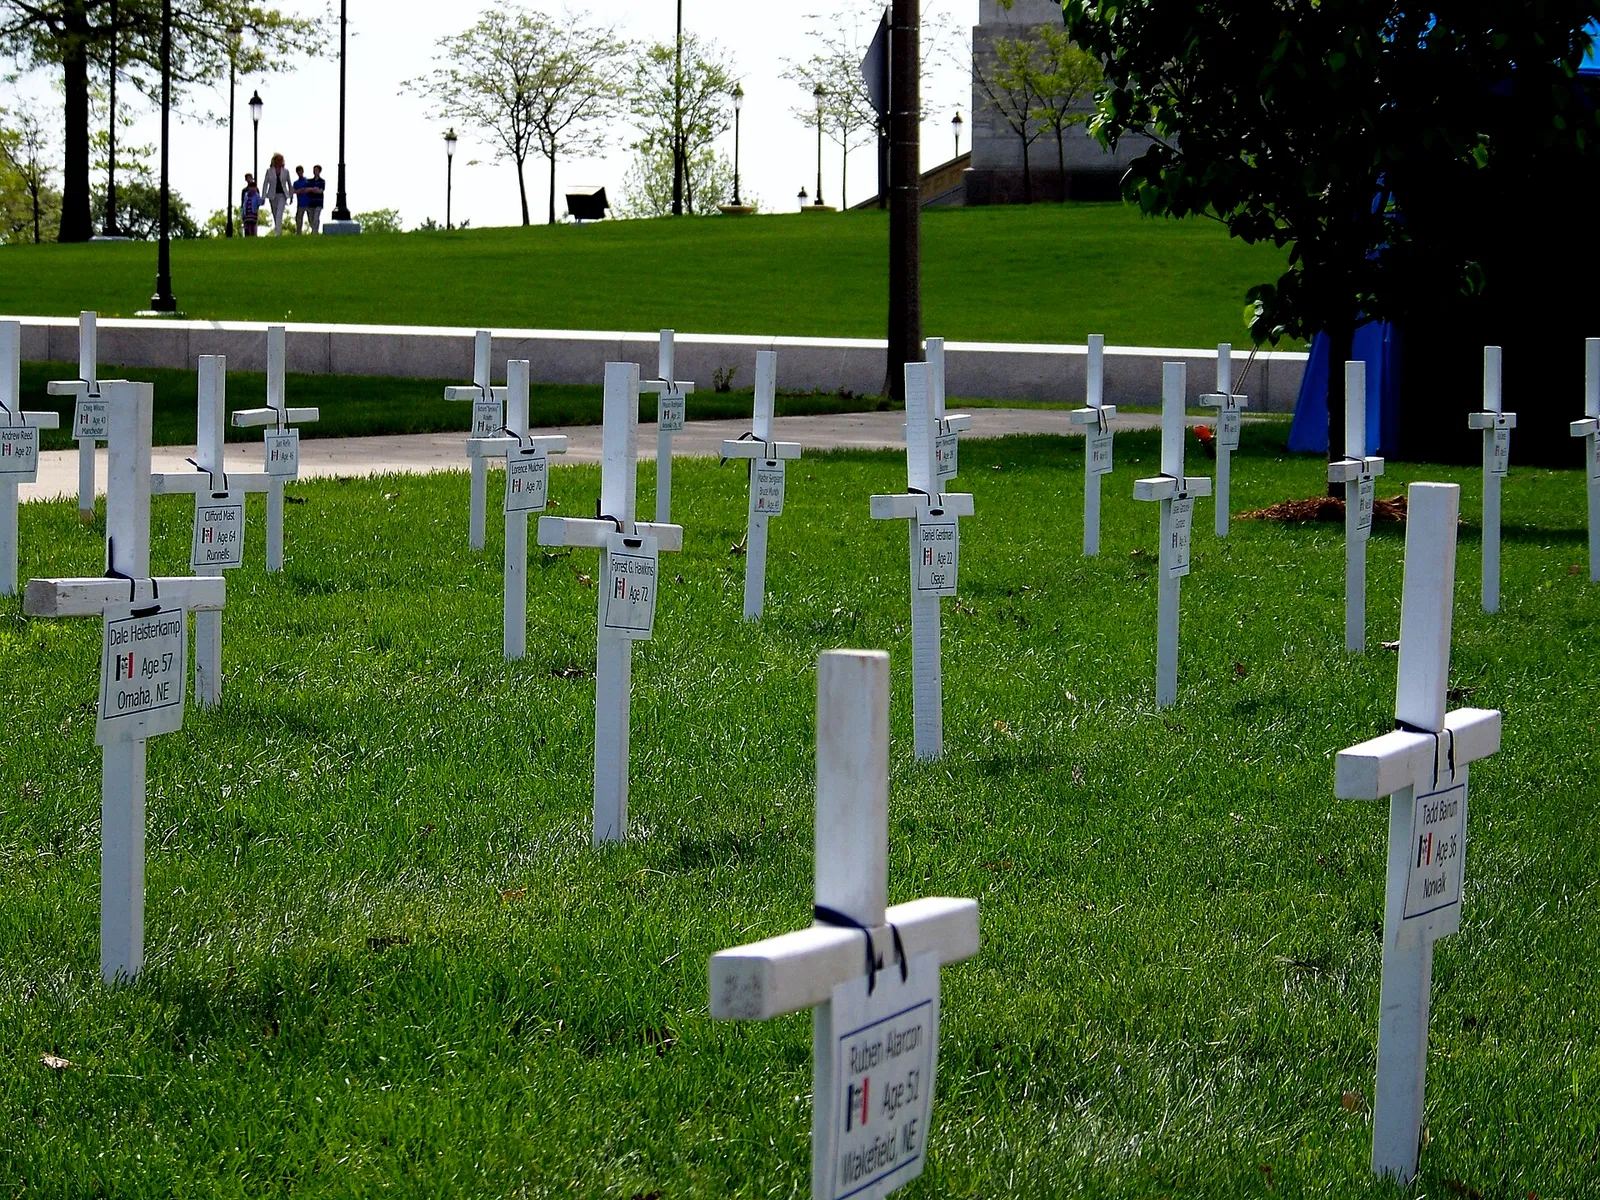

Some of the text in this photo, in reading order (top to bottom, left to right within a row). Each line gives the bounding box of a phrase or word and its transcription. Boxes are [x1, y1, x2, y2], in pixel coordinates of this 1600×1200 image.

[93, 416, 101, 425] Age
[2, 430, 33, 441] Andrew Reed
[15, 446, 32, 458] Age 27
[526, 481, 535, 494] Age
[204, 510, 235, 522] Clifford Mast
[217, 530, 236, 546] Age 64
[922, 528, 935, 541] Daniel
[612, 558, 628, 573] Forrest
[634, 561, 654, 577] Hawkins
[937, 551, 953, 568] Age 22
[931, 571, 945, 588] Osage
[628, 585, 649, 604] Age 72
[110, 620, 181, 646] Dale Heisterkamp
[141, 652, 173, 680] Age 57
[117, 681, 170, 710] Omaha, NE
[1422, 802, 1438, 826] Tadd
[1435, 834, 1457, 867] Age 36
[1422, 872, 1447, 899] Norwalk
[850, 1024, 924, 1075] Ruben Alarcon
[881, 1069, 921, 1121] Age 51
[842, 1118, 919, 1187] Wakefield, NE
